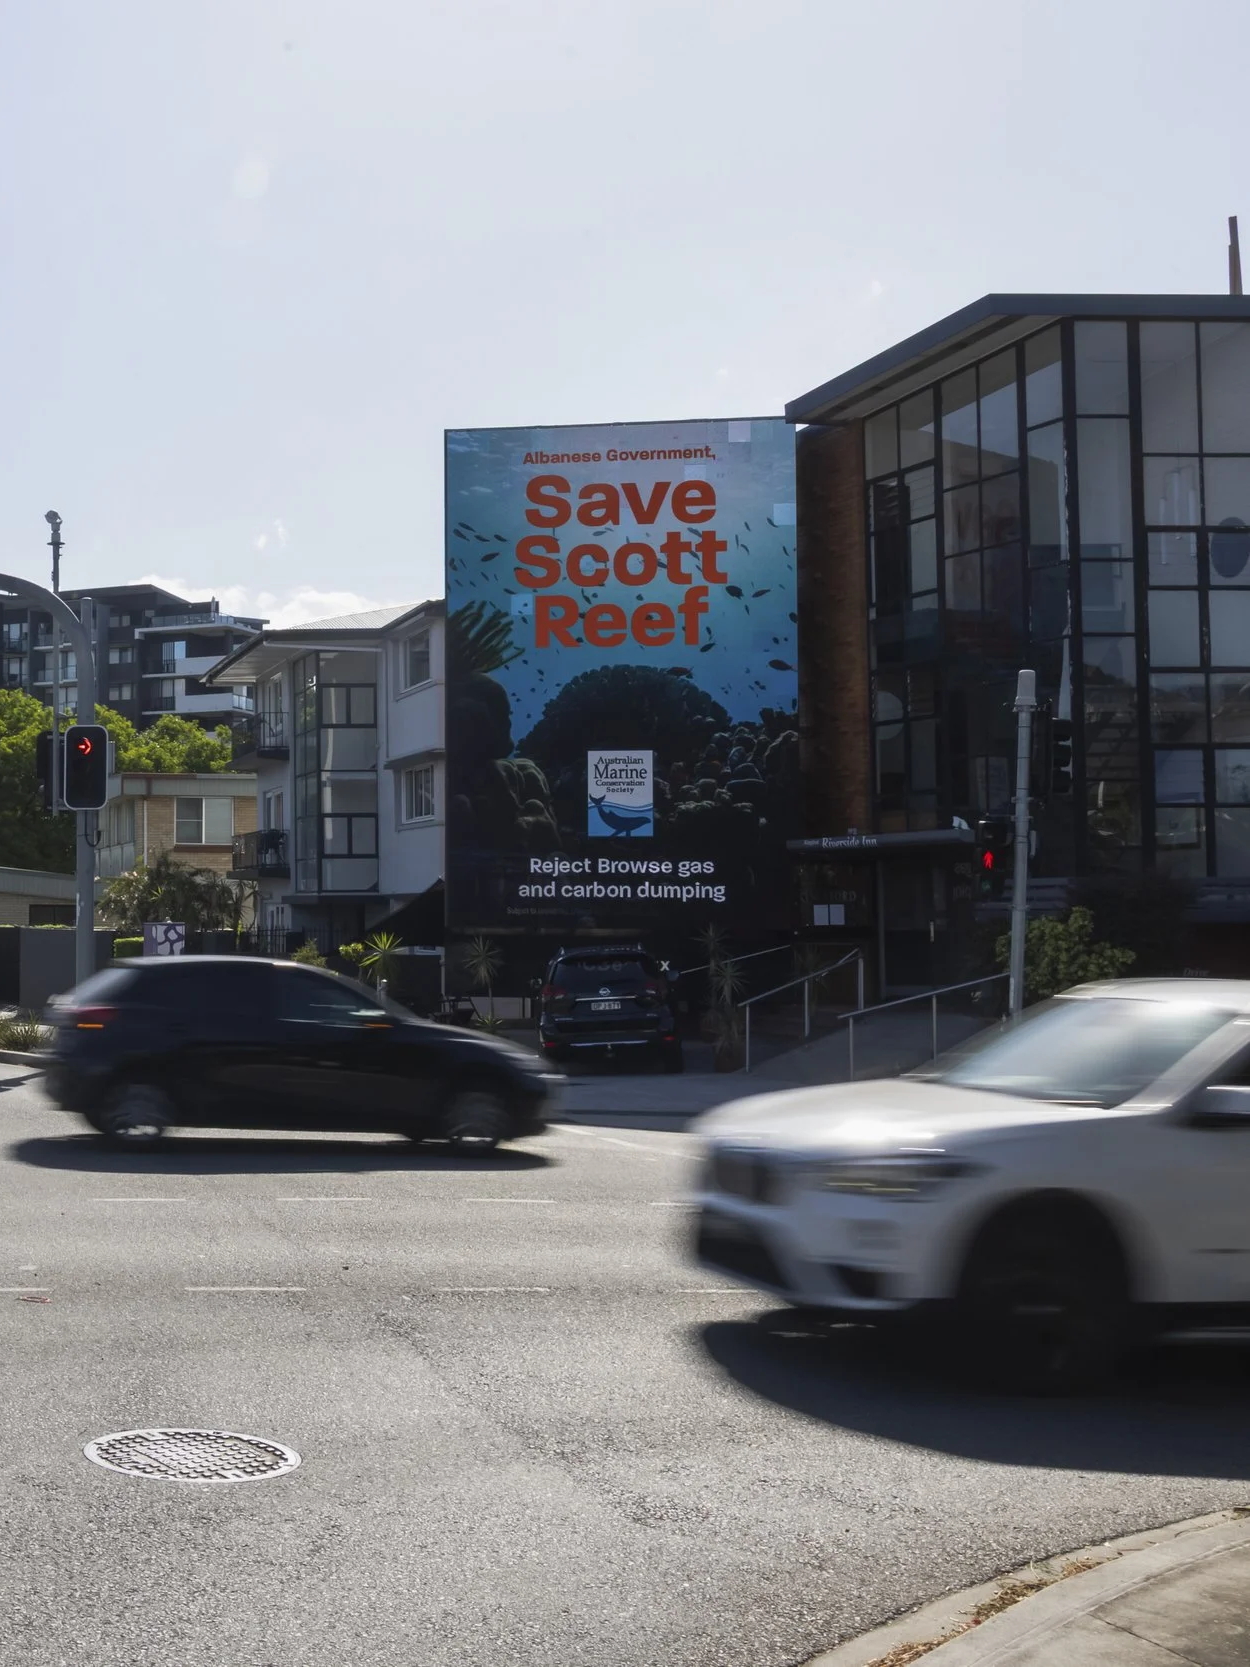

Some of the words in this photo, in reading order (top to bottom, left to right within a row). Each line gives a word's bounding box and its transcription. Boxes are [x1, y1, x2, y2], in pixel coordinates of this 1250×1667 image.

[522, 449, 602, 466] Albanese
[606, 445, 717, 462] Government,
[524, 474, 717, 529] Save
[513, 530, 729, 589] Scott
[534, 585, 710, 649] Reef
[596, 755, 644, 765] Australian
[593, 764, 648, 780] Marine
[595, 779, 645, 787] Conservation
[606, 787, 635, 795] Society
[821, 836, 860, 849] Riverside
[862, 835, 878, 847] Inn
[529, 856, 592, 877] Reject
[597, 857, 673, 877] Browse
[678, 860, 715, 878] gas
[518, 880, 556, 899] and
[560, 880, 632, 900] carbon
[636, 881, 726, 902] dumping
